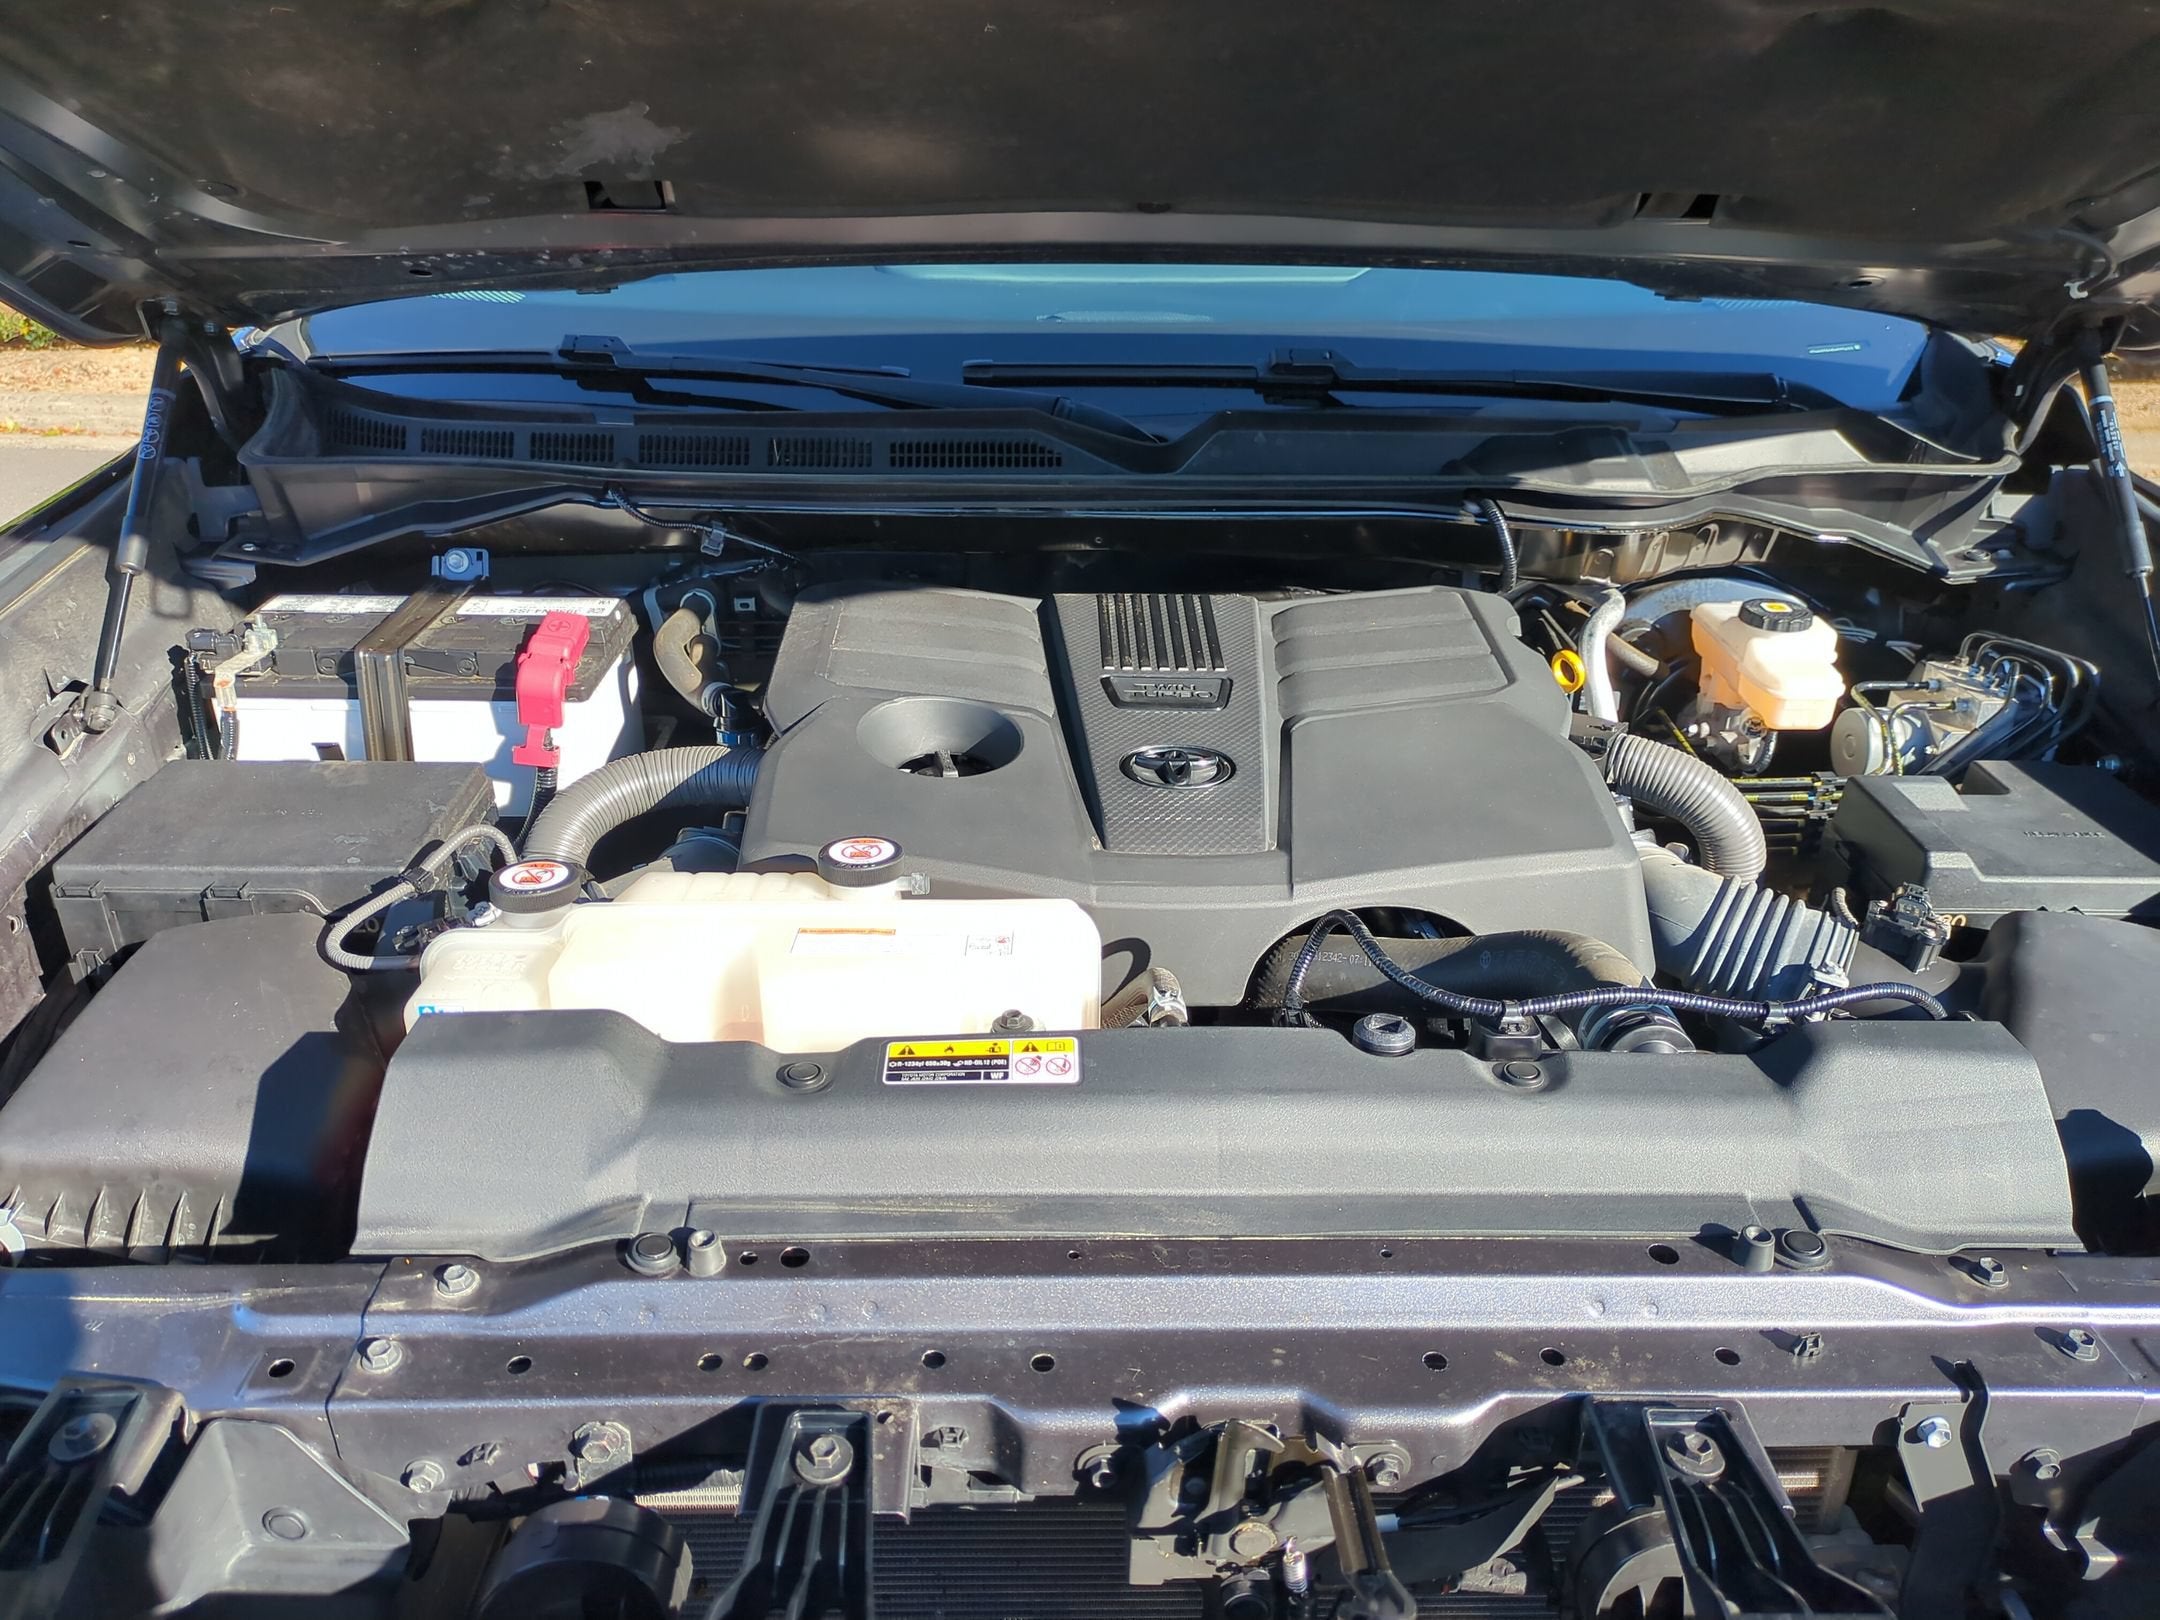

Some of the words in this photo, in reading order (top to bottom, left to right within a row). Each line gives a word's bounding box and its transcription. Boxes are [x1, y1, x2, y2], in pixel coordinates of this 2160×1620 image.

[1133, 683, 1196, 691] TWIN
[1123, 690, 1214, 698] TURBO
[990, 1071, 1005, 1080] WF
